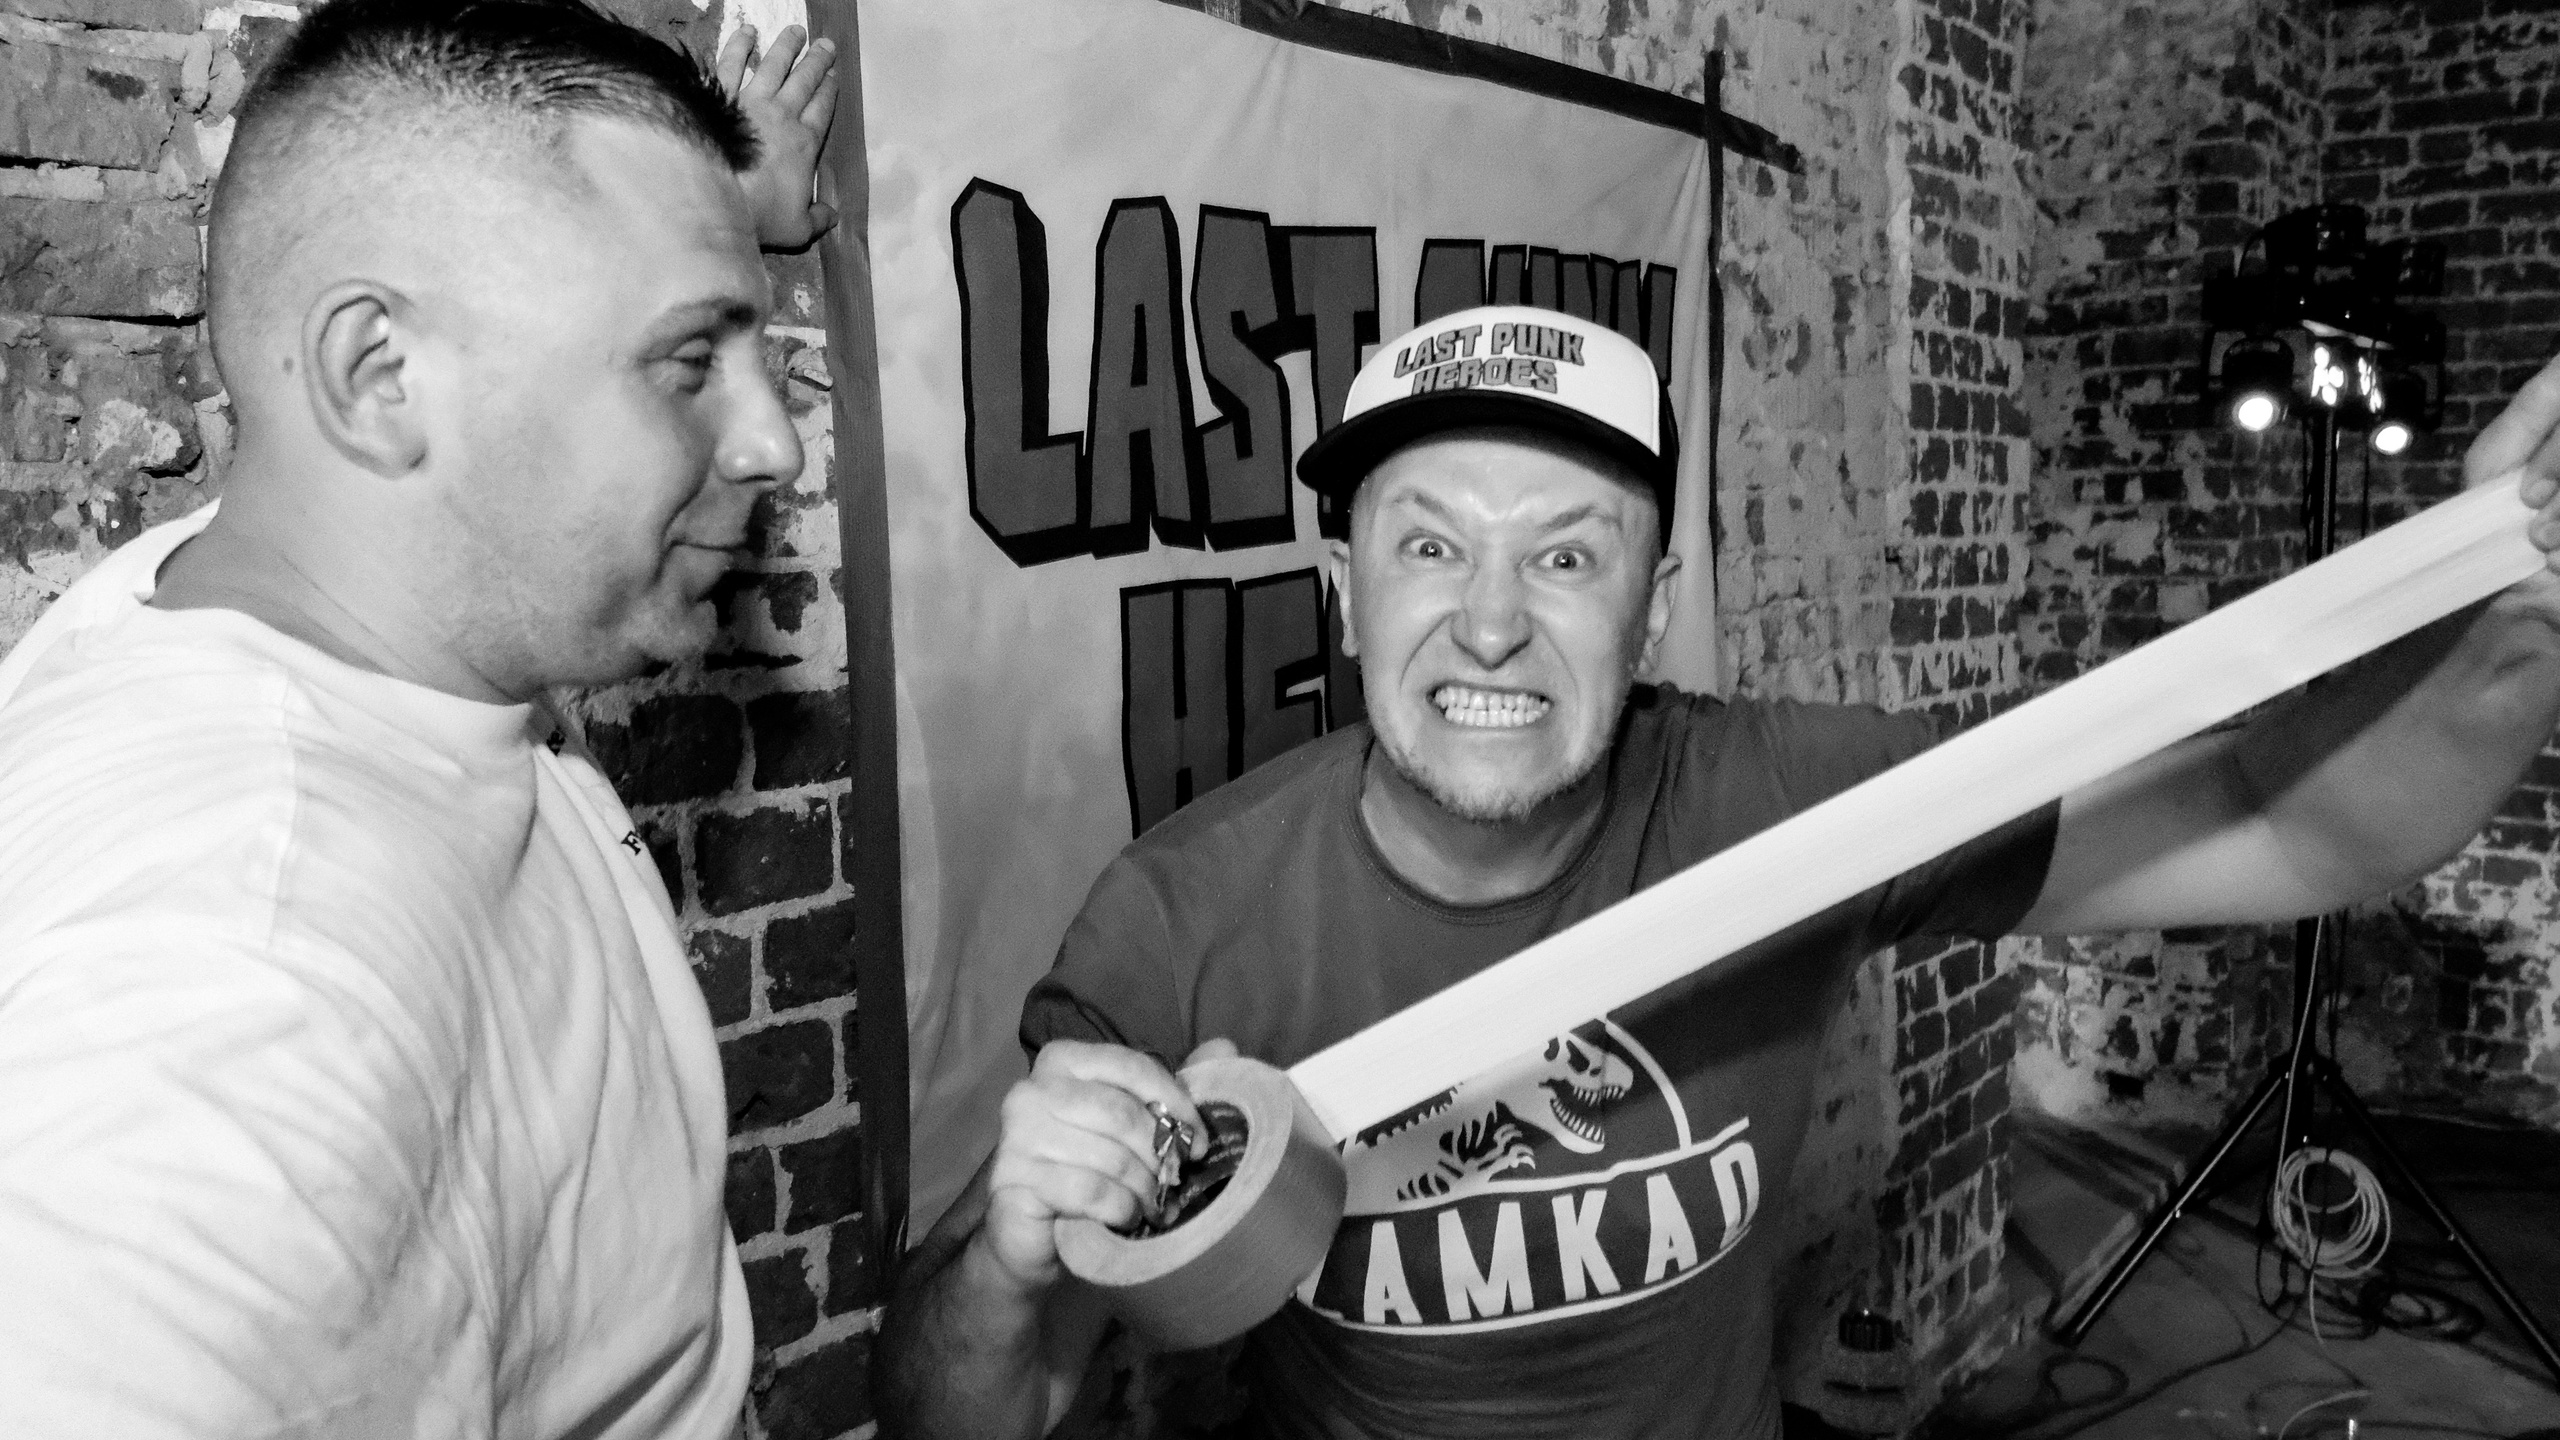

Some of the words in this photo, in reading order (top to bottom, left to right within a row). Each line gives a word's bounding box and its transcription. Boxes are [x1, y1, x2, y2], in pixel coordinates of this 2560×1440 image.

[950, 176, 1381, 568] LAST
[1394, 325, 1483, 378] LAST
[1491, 322, 1585, 367] PUNK
[1412, 358, 1557, 394] HEROES
[1297, 1142, 1760, 1326] AMKAD
